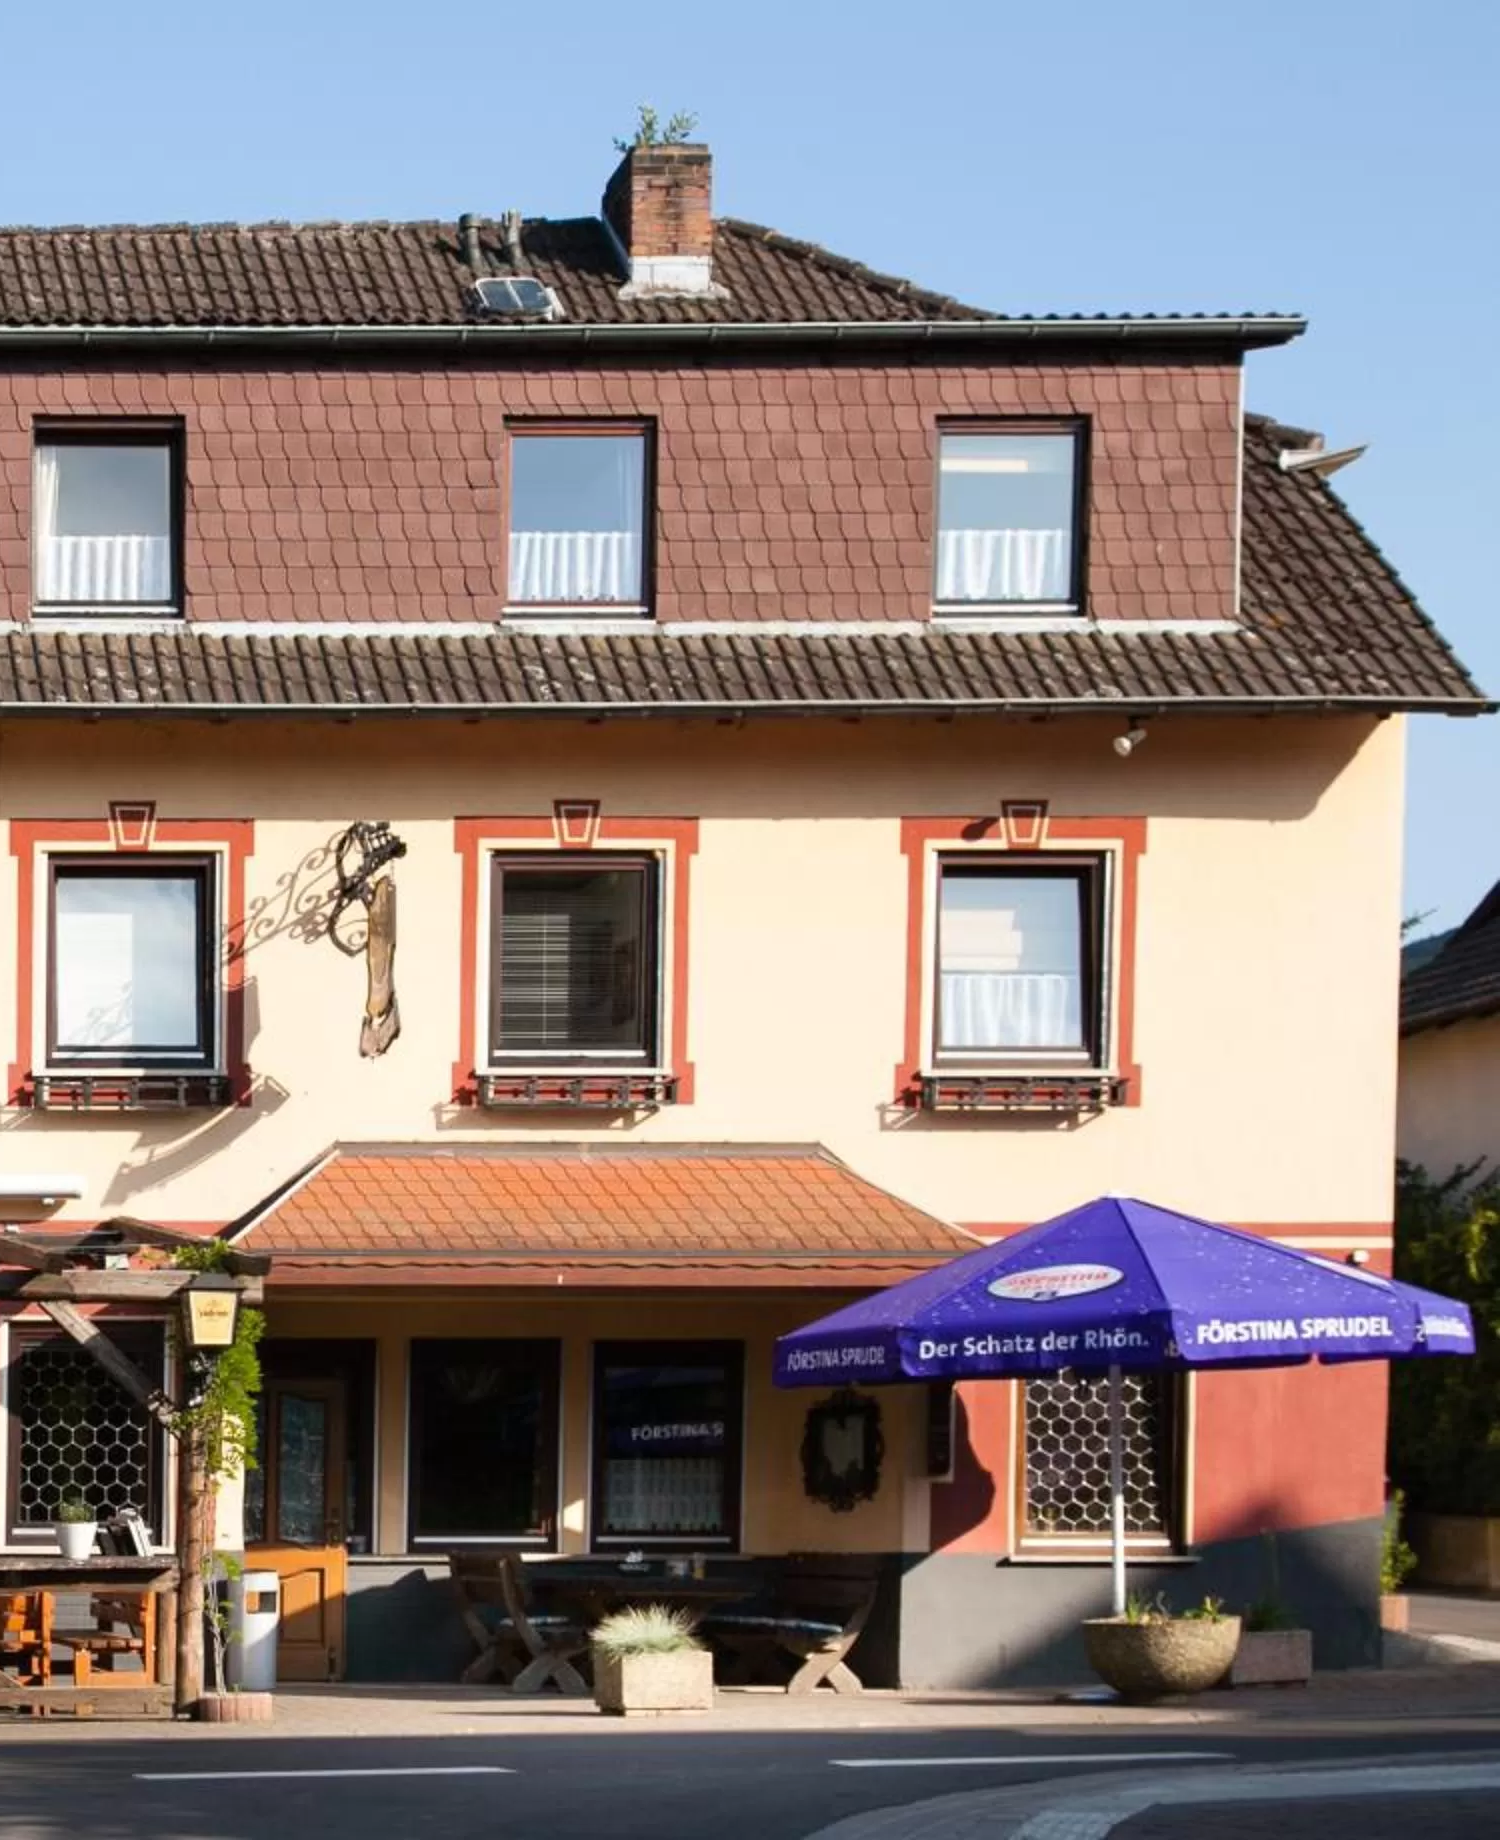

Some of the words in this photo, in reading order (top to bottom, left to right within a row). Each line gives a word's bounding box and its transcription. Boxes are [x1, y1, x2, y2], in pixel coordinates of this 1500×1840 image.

[919, 1340, 957, 1360] Der
[963, 1332, 1035, 1356] Schatz
[1041, 1330, 1078, 1351] der
[1084, 1327, 1149, 1349] Rhön.
[1197, 1319, 1298, 1345] FÖRSTINA
[1301, 1316, 1393, 1340] SPRUDEL
[841, 1345, 885, 1366] SPRUDE
